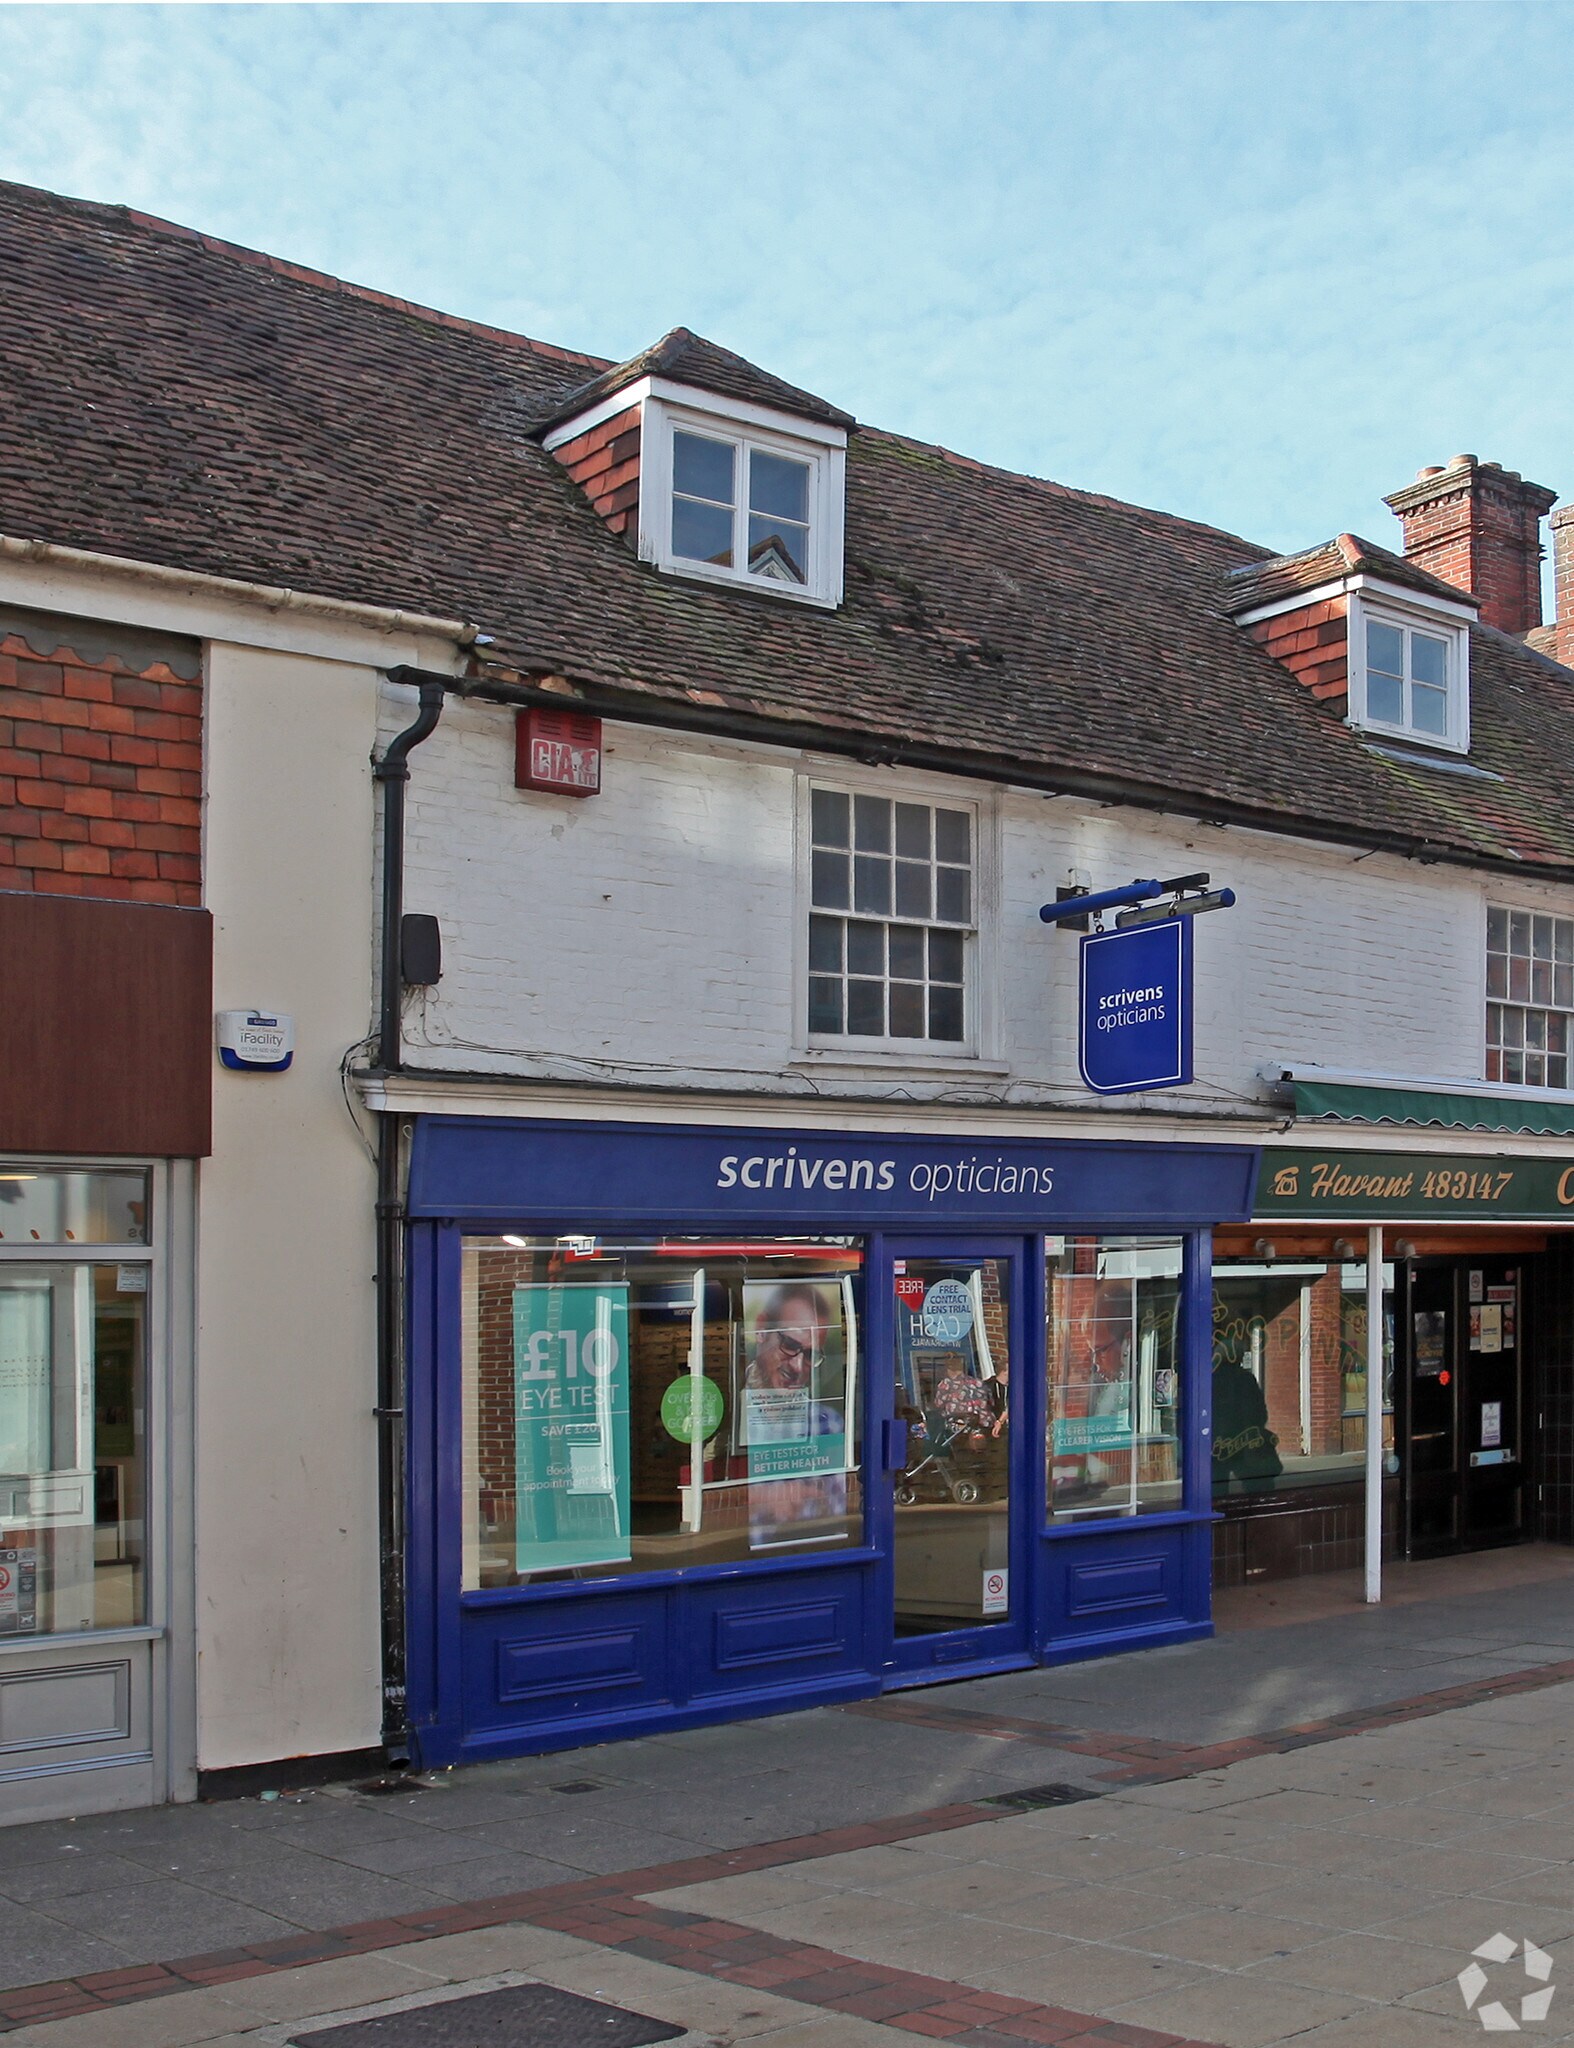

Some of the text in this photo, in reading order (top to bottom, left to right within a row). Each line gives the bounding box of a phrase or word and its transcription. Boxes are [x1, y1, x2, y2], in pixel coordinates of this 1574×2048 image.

[532, 741, 575, 783] CIA
[1099, 985, 1164, 1009] scrivens
[1096, 1005, 1166, 1033] opticians
[240, 1033, 284, 1047] iFacility
[717, 1146, 1055, 1202] scrivens opticians
[1310, 1163, 1514, 1200] Havant 483147
[939, 1285, 959, 1294] FREE
[929, 1295, 968, 1305] CONTACT
[926, 1305, 972, 1314] LENS TRIAL
[522, 1328, 619, 1381] £10
[521, 1384, 620, 1410] EYE TEST
[541, 1424, 572, 1437] SAVE
[1057, 1435, 1093, 1447] CLEARER
[753, 1445, 819, 1462] EYE TESTS FOR
[546, 1465, 573, 1476] Book
[753, 1456, 830, 1473] BETTER HEALTH
[591, 1474, 621, 1486] toay
